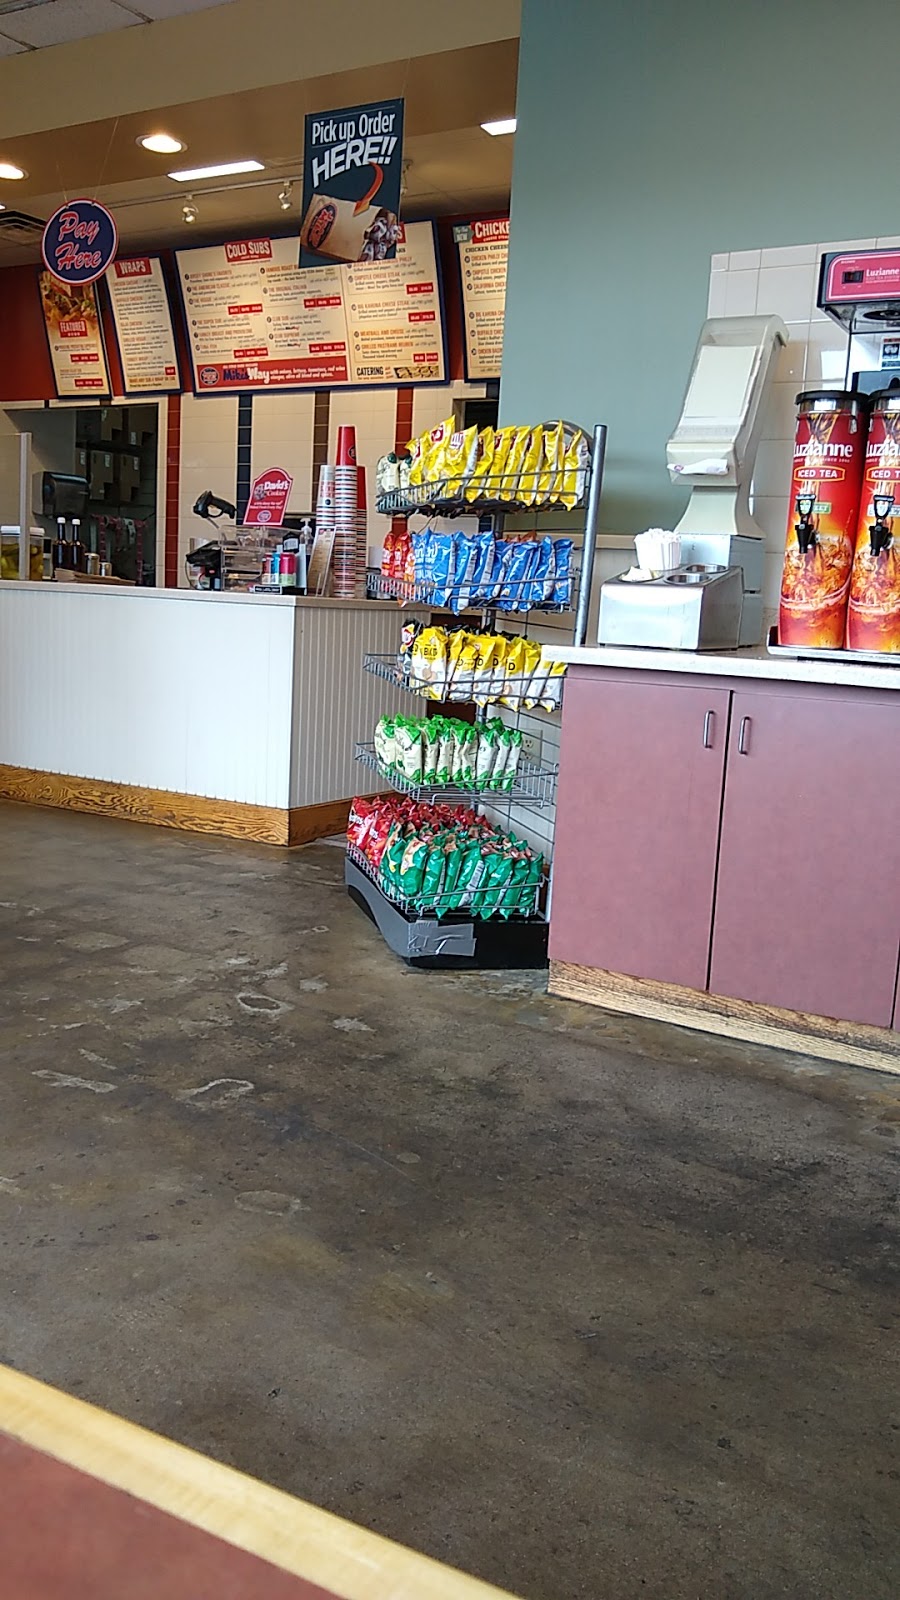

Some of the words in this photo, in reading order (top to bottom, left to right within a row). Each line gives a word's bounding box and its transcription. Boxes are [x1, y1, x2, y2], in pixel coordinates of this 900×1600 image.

[312, 119, 337, 145] Pick
[338, 121, 356, 142] up
[358, 111, 396, 137] Order
[311, 136, 398, 188] HERE!!
[58, 210, 100, 245] Pay
[55, 241, 102, 271] Here
[226, 243, 247, 258] COLD
[248, 241, 271, 255] SUBS
[119, 260, 146, 275] WRAPS
[246, 367, 270, 384] Way
[357, 366, 384, 376] CATERING
[797, 470, 816, 478] ICED
[819, 469, 838, 478] TEA
[871, 470, 891, 478] ICED
